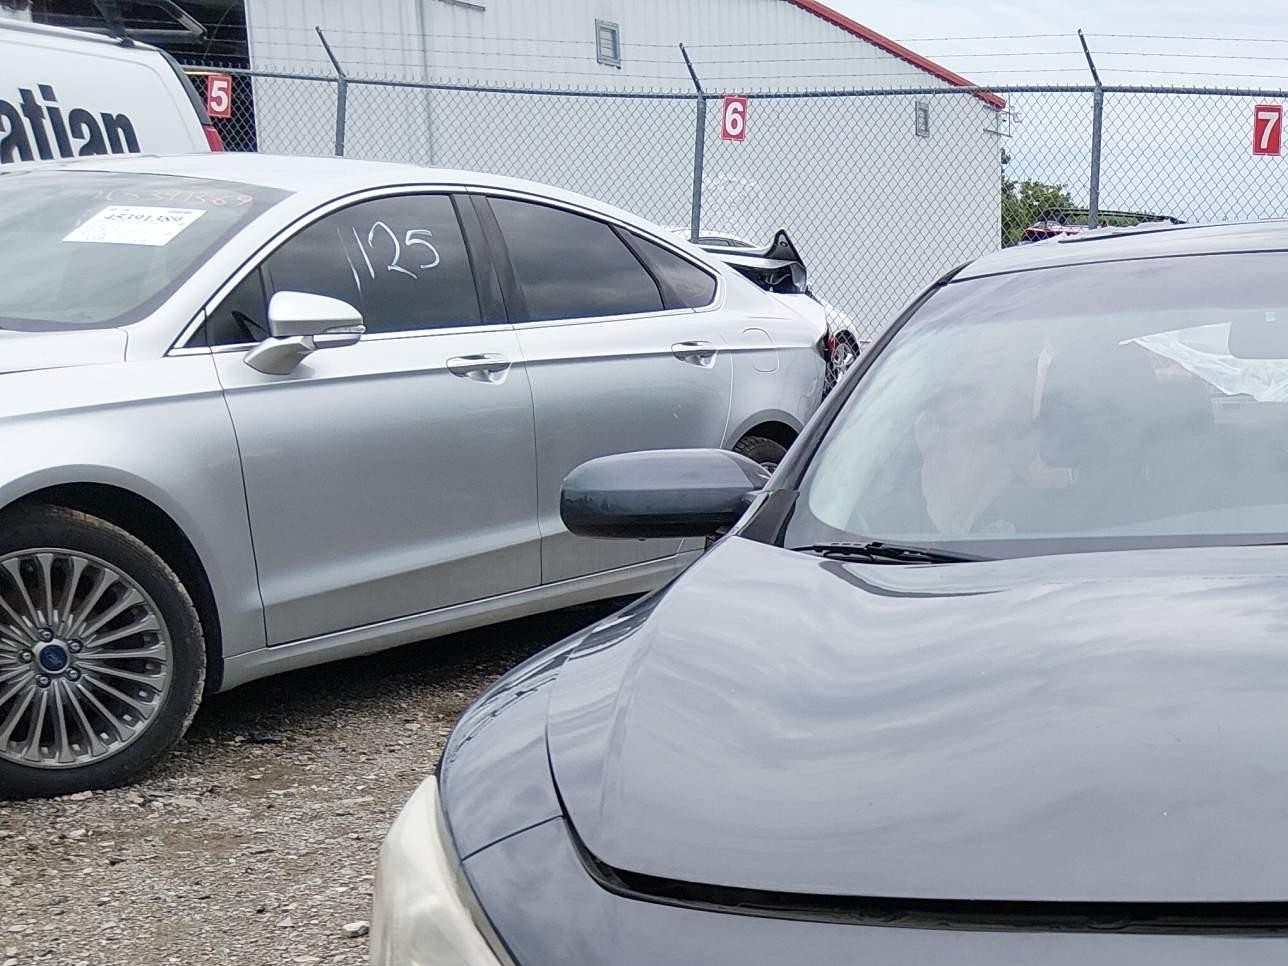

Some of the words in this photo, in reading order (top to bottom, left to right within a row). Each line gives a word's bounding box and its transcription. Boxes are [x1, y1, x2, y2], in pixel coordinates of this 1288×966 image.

[211, 80, 229, 112] 5
[724, 101, 744, 134] 6
[1257, 110, 1279, 150] 7
